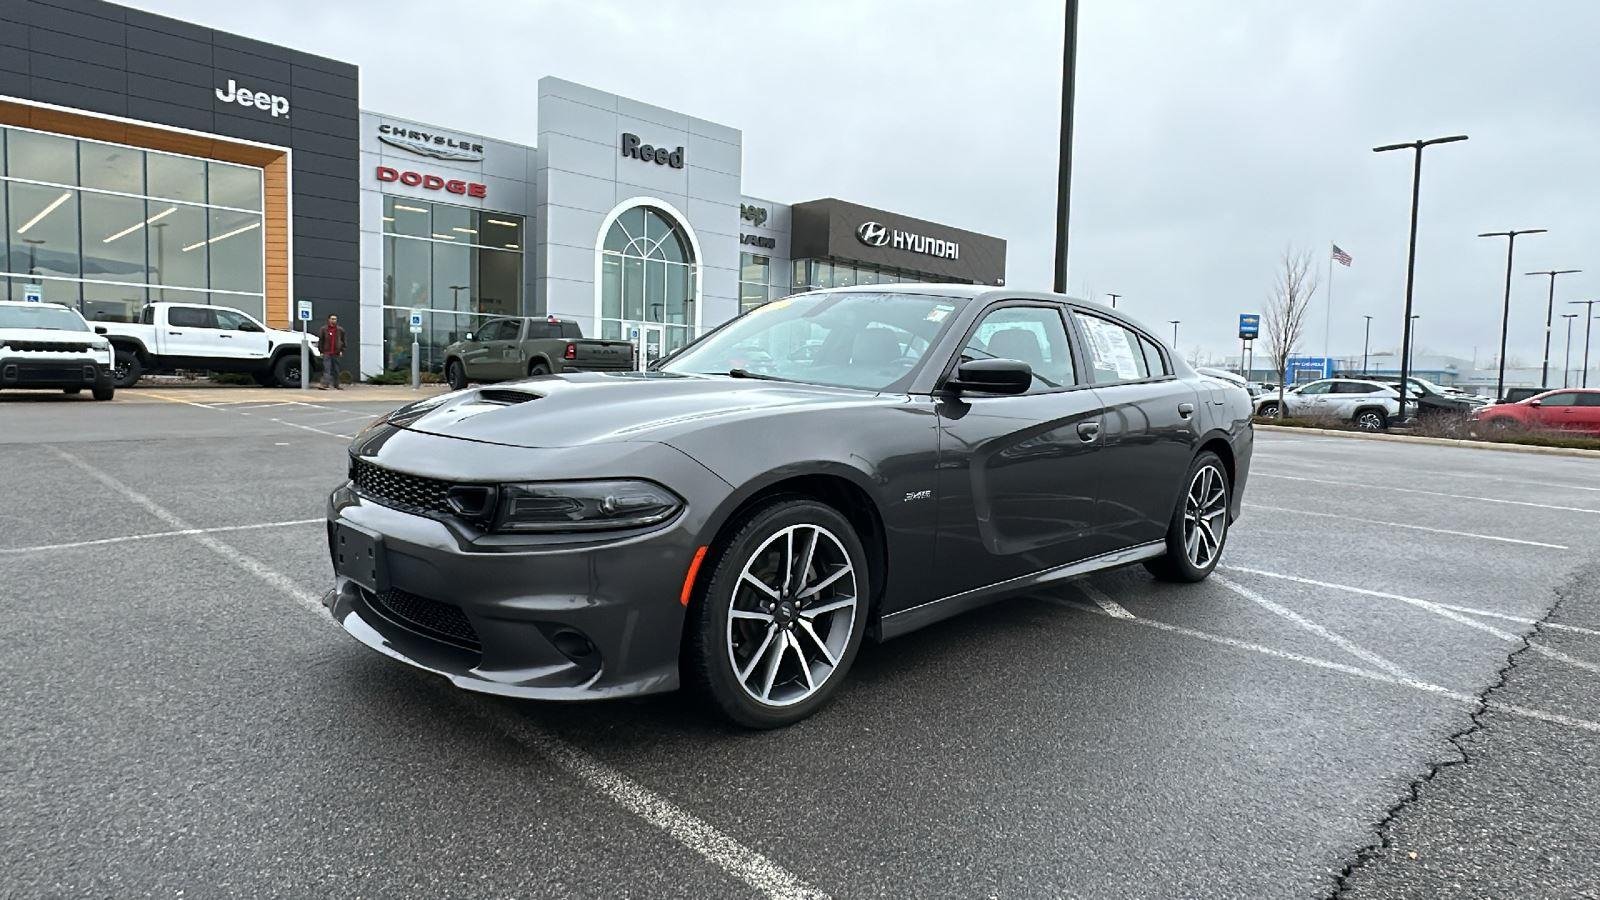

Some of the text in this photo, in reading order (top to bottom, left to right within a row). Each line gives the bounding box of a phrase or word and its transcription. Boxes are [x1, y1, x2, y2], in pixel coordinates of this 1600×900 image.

[215, 79, 290, 118] Jeep
[379, 124, 484, 153] CHRYSLER
[622, 132, 685, 169] Reed
[376, 166, 487, 198] DODGE
[893, 229, 959, 259] HYUNDAI
